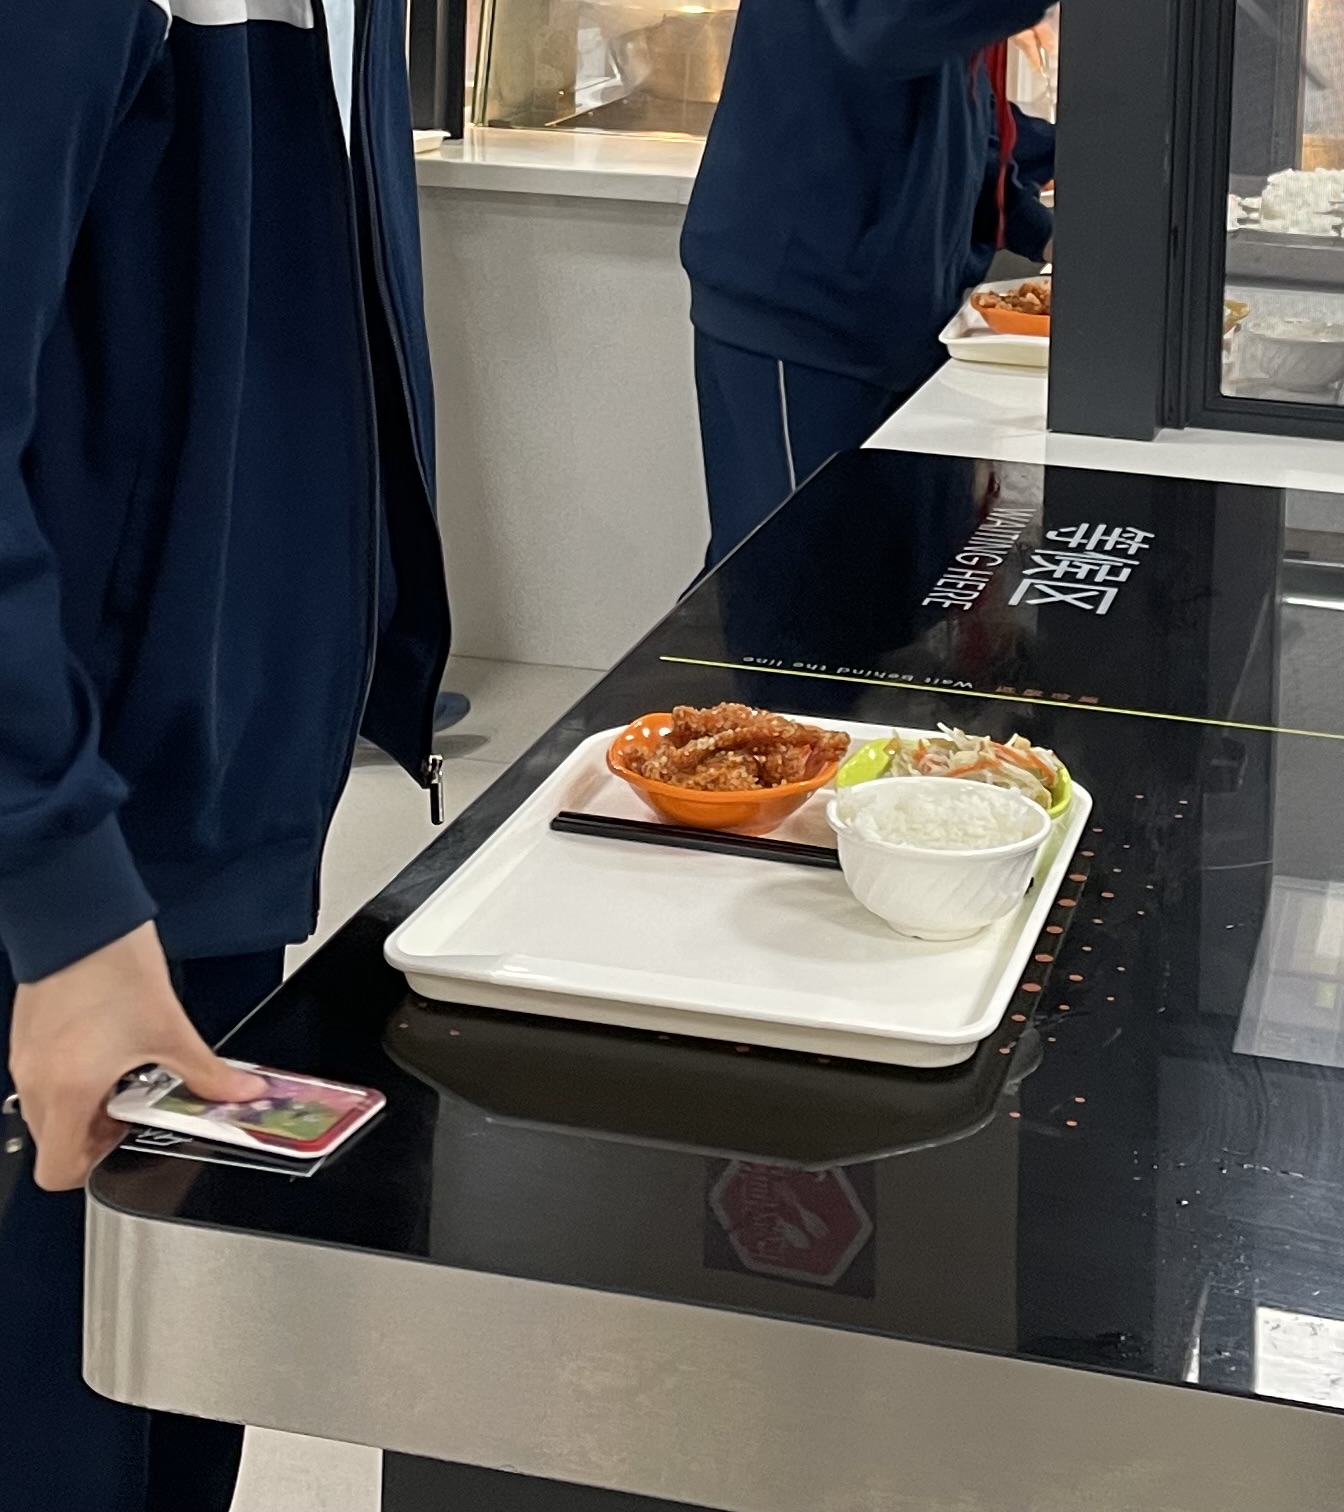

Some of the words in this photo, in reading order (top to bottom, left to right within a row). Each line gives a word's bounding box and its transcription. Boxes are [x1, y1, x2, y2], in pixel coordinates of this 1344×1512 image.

[955, 507, 1038, 567] WAITING
[1008, 522, 1156, 615] 等候区
[921, 569, 994, 611] HERE
[741, 655, 784, 666] line
[791, 660, 828, 671] the
[837, 666, 915, 683] behind
[921, 676, 974, 689] Wait
